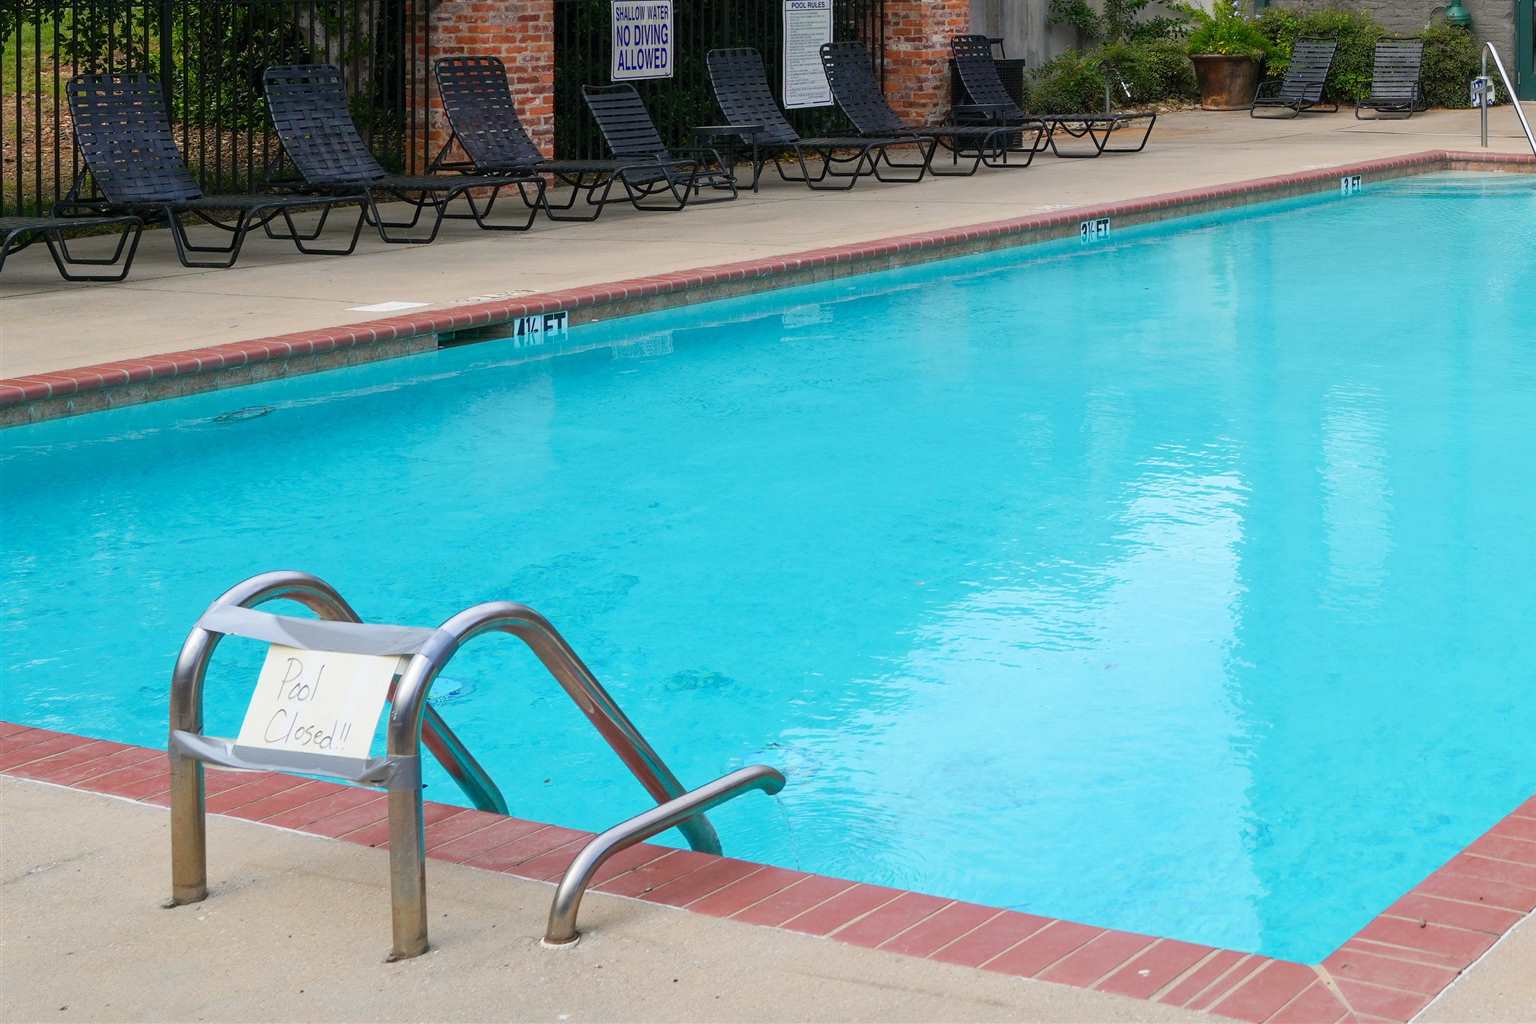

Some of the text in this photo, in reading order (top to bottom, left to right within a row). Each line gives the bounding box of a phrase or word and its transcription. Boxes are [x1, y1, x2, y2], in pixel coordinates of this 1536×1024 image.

[615, 5, 669, 21] SHALLOW WATER
[791, 1, 806, 9] POOL
[616, 23, 668, 47] NO DIVING
[617, 47, 668, 71] ALLOWED
[1096, 218, 1109, 233] FT
[543, 312, 567, 332] FT
[277, 657, 325, 702] Pool
[264, 708, 352, 750] Closed!!
